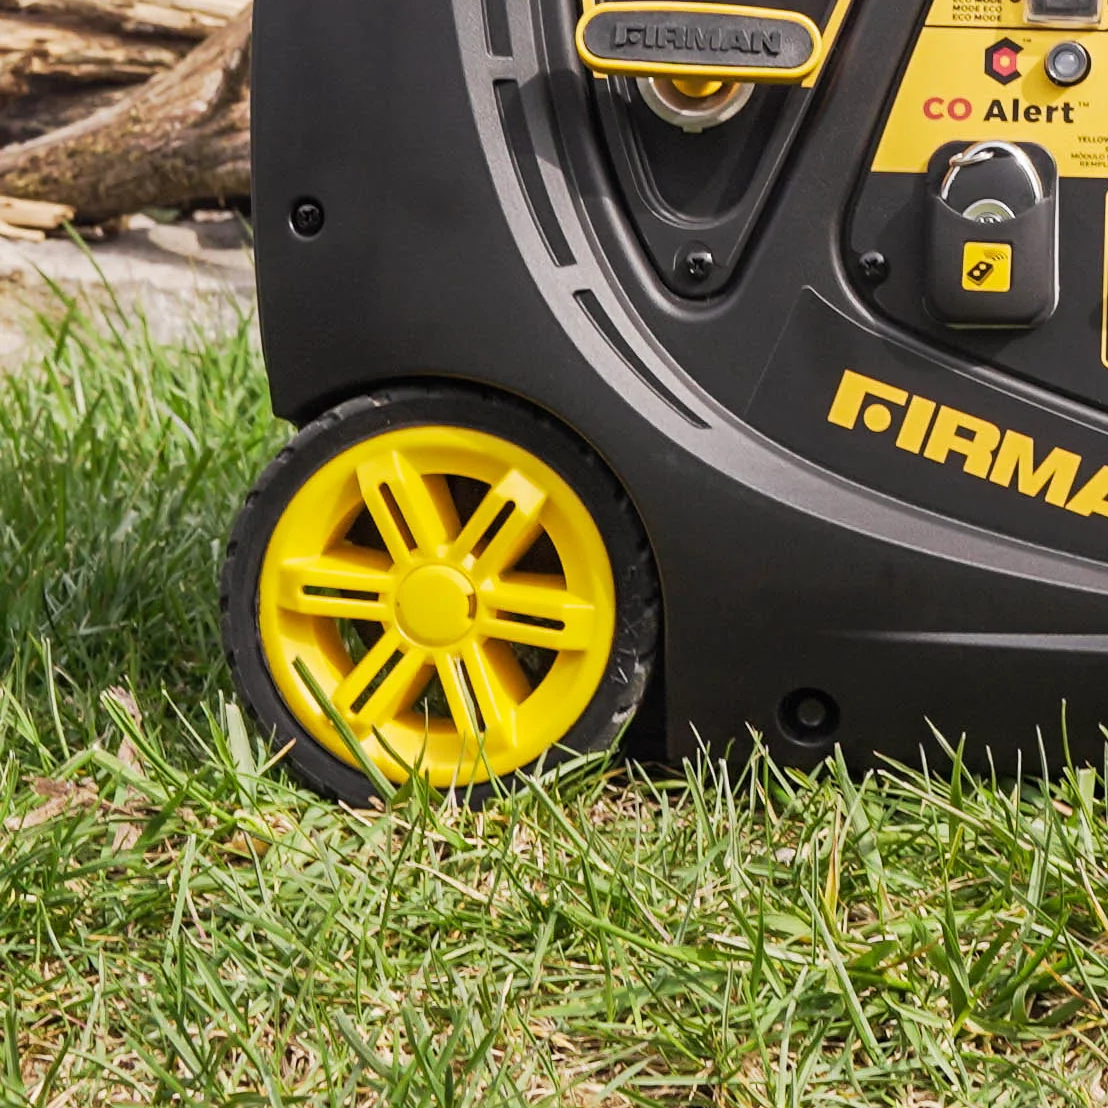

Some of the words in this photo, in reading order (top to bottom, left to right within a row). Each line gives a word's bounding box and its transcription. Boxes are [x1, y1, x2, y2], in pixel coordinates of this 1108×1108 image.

[952, 4, 981, 13] MODE
[983, 5, 1003, 13] ECO
[952, 13, 971, 21] ECO
[974, 14, 1001, 22] MODE
[613, 23, 782, 57] FIRMAN
[923, 97, 972, 121] CO
[983, 99, 1075, 124] Alert
